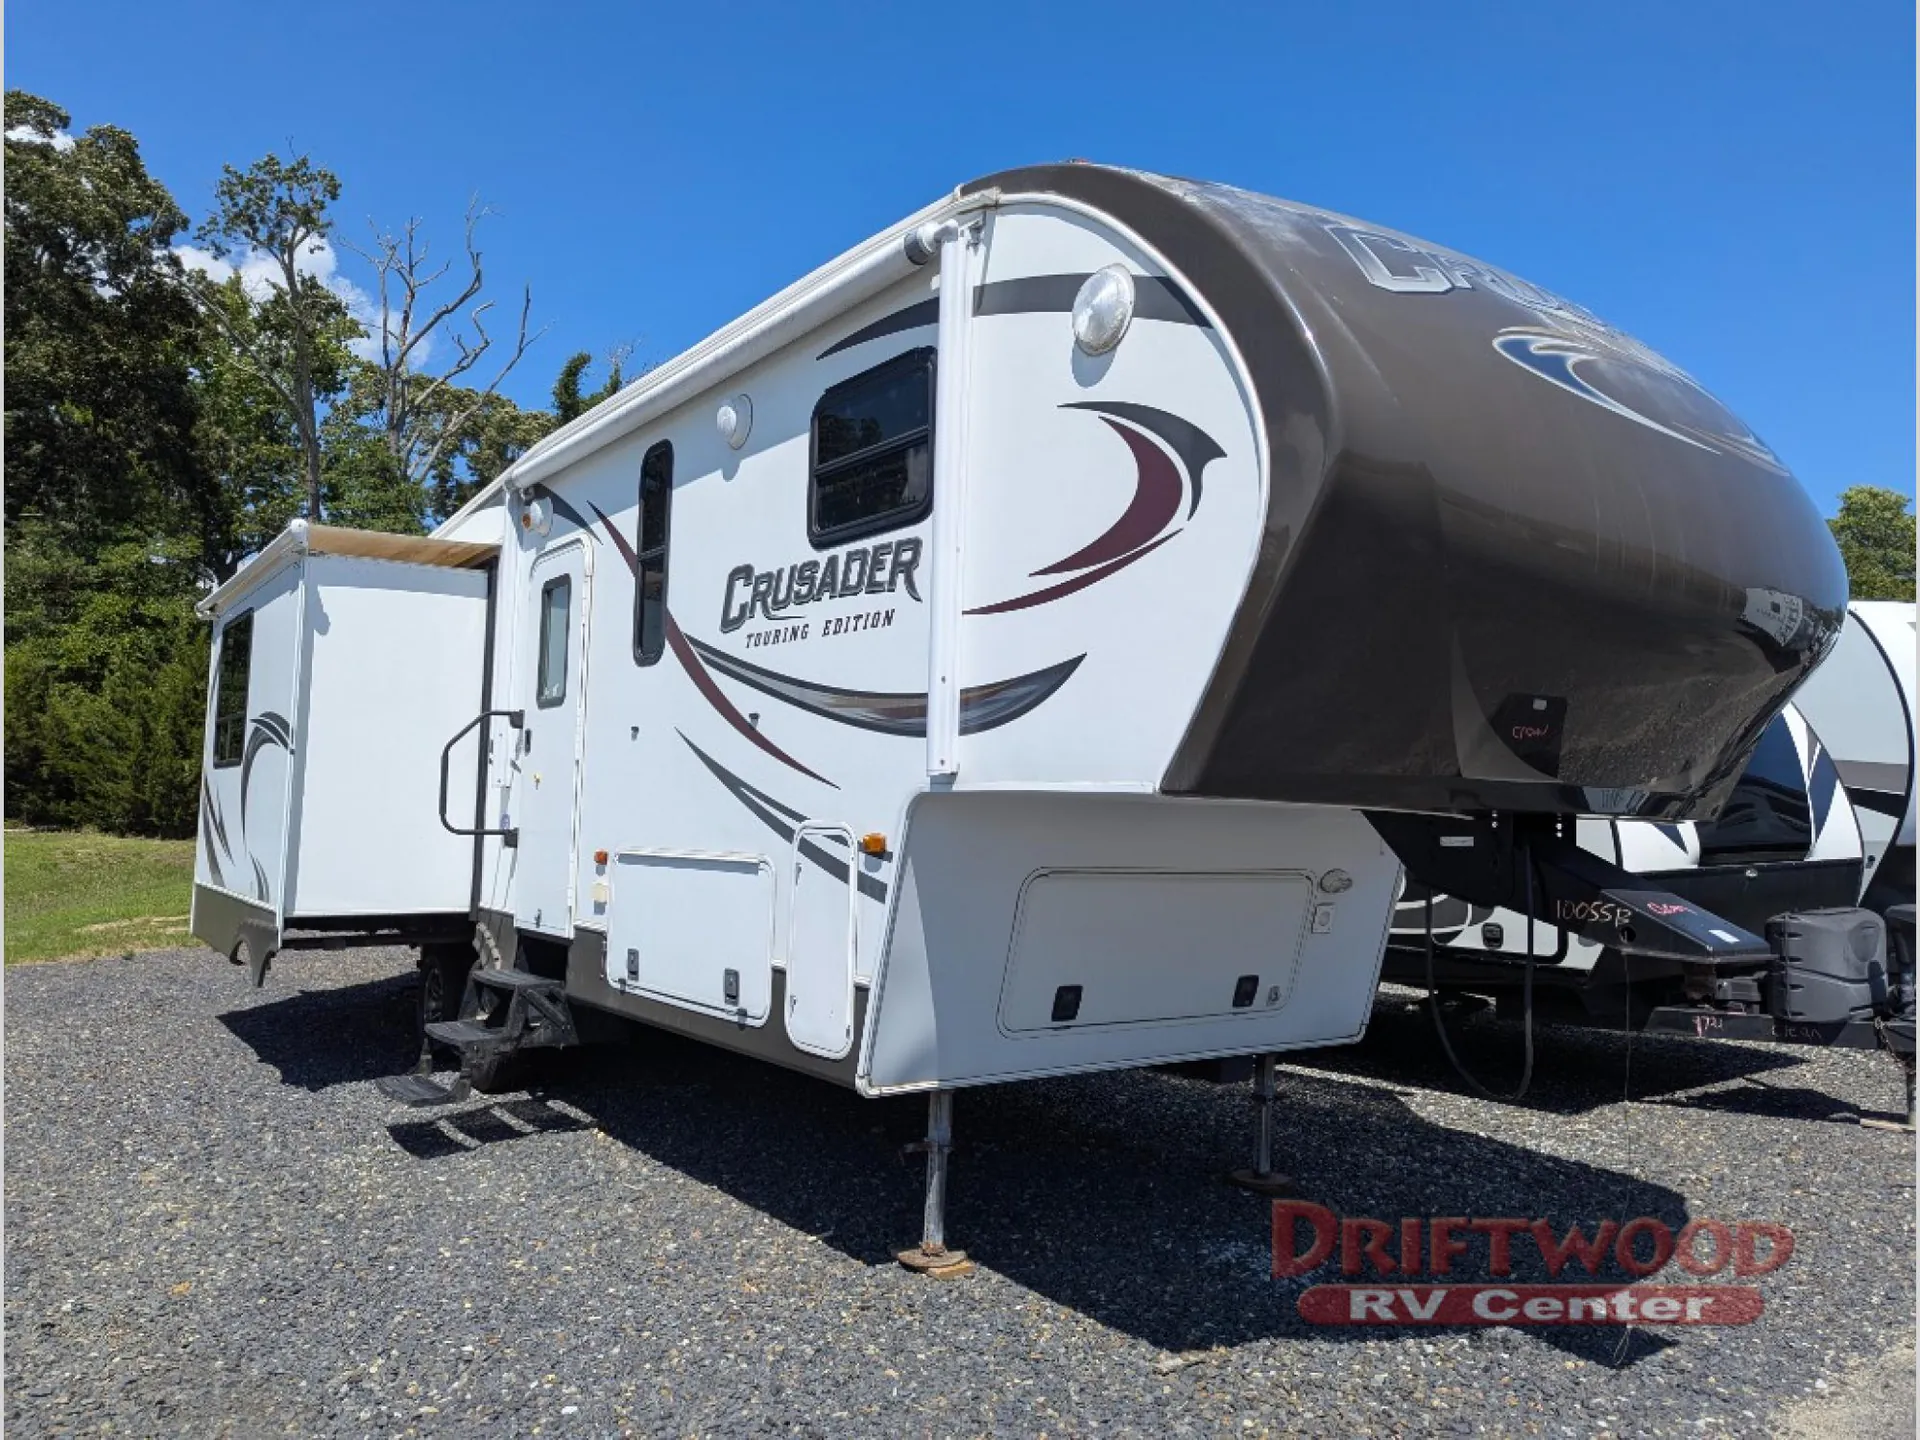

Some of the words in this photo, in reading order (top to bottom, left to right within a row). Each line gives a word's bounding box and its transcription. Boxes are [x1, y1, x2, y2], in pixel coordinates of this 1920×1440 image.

[719, 536, 923, 634] CRUSADER
[745, 623, 810, 649] TOURING
[821, 608, 896, 637] EDITION
